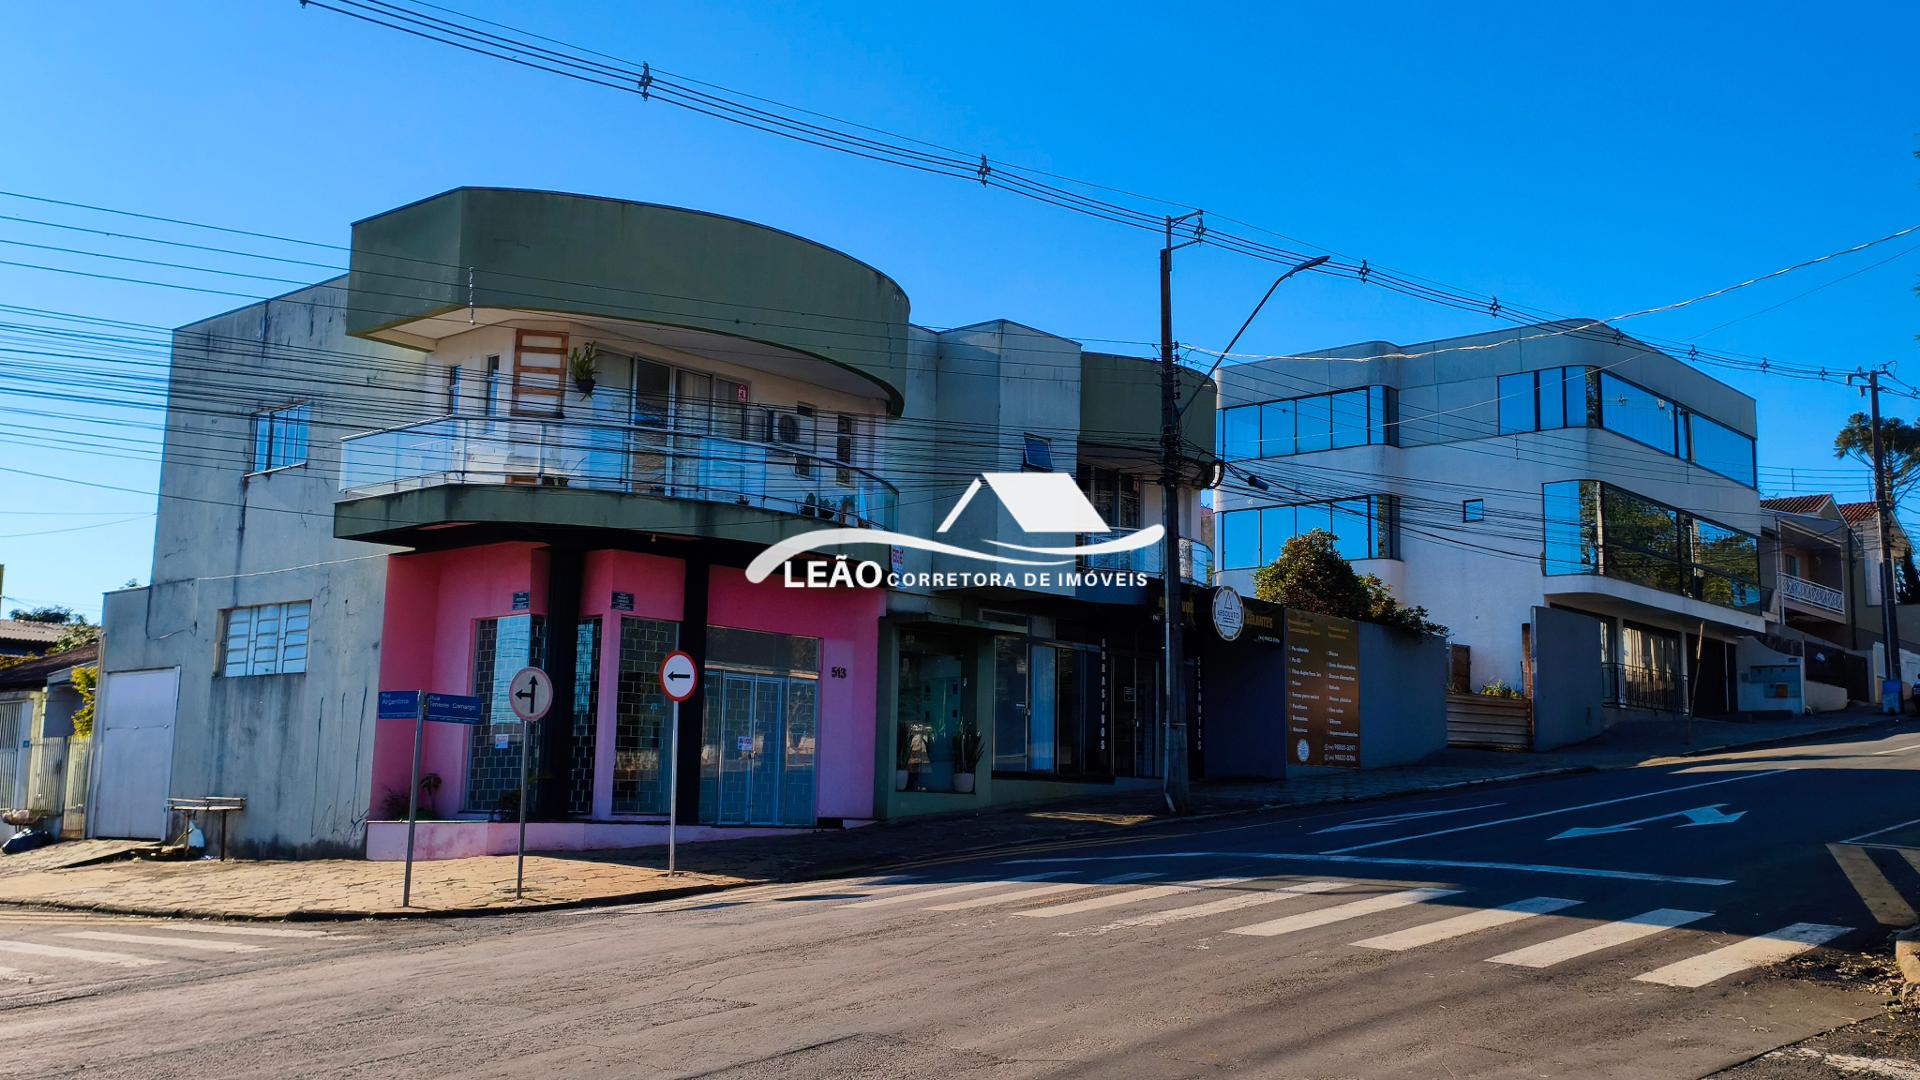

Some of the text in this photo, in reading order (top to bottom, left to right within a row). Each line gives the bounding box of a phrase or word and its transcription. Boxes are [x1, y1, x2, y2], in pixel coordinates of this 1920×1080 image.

[1217, 609, 1240, 619] ABSOLUTO
[831, 666, 847, 679] 513
[381, 698, 409, 706] Argentina
[429, 700, 477, 711] Tenente Camargo
